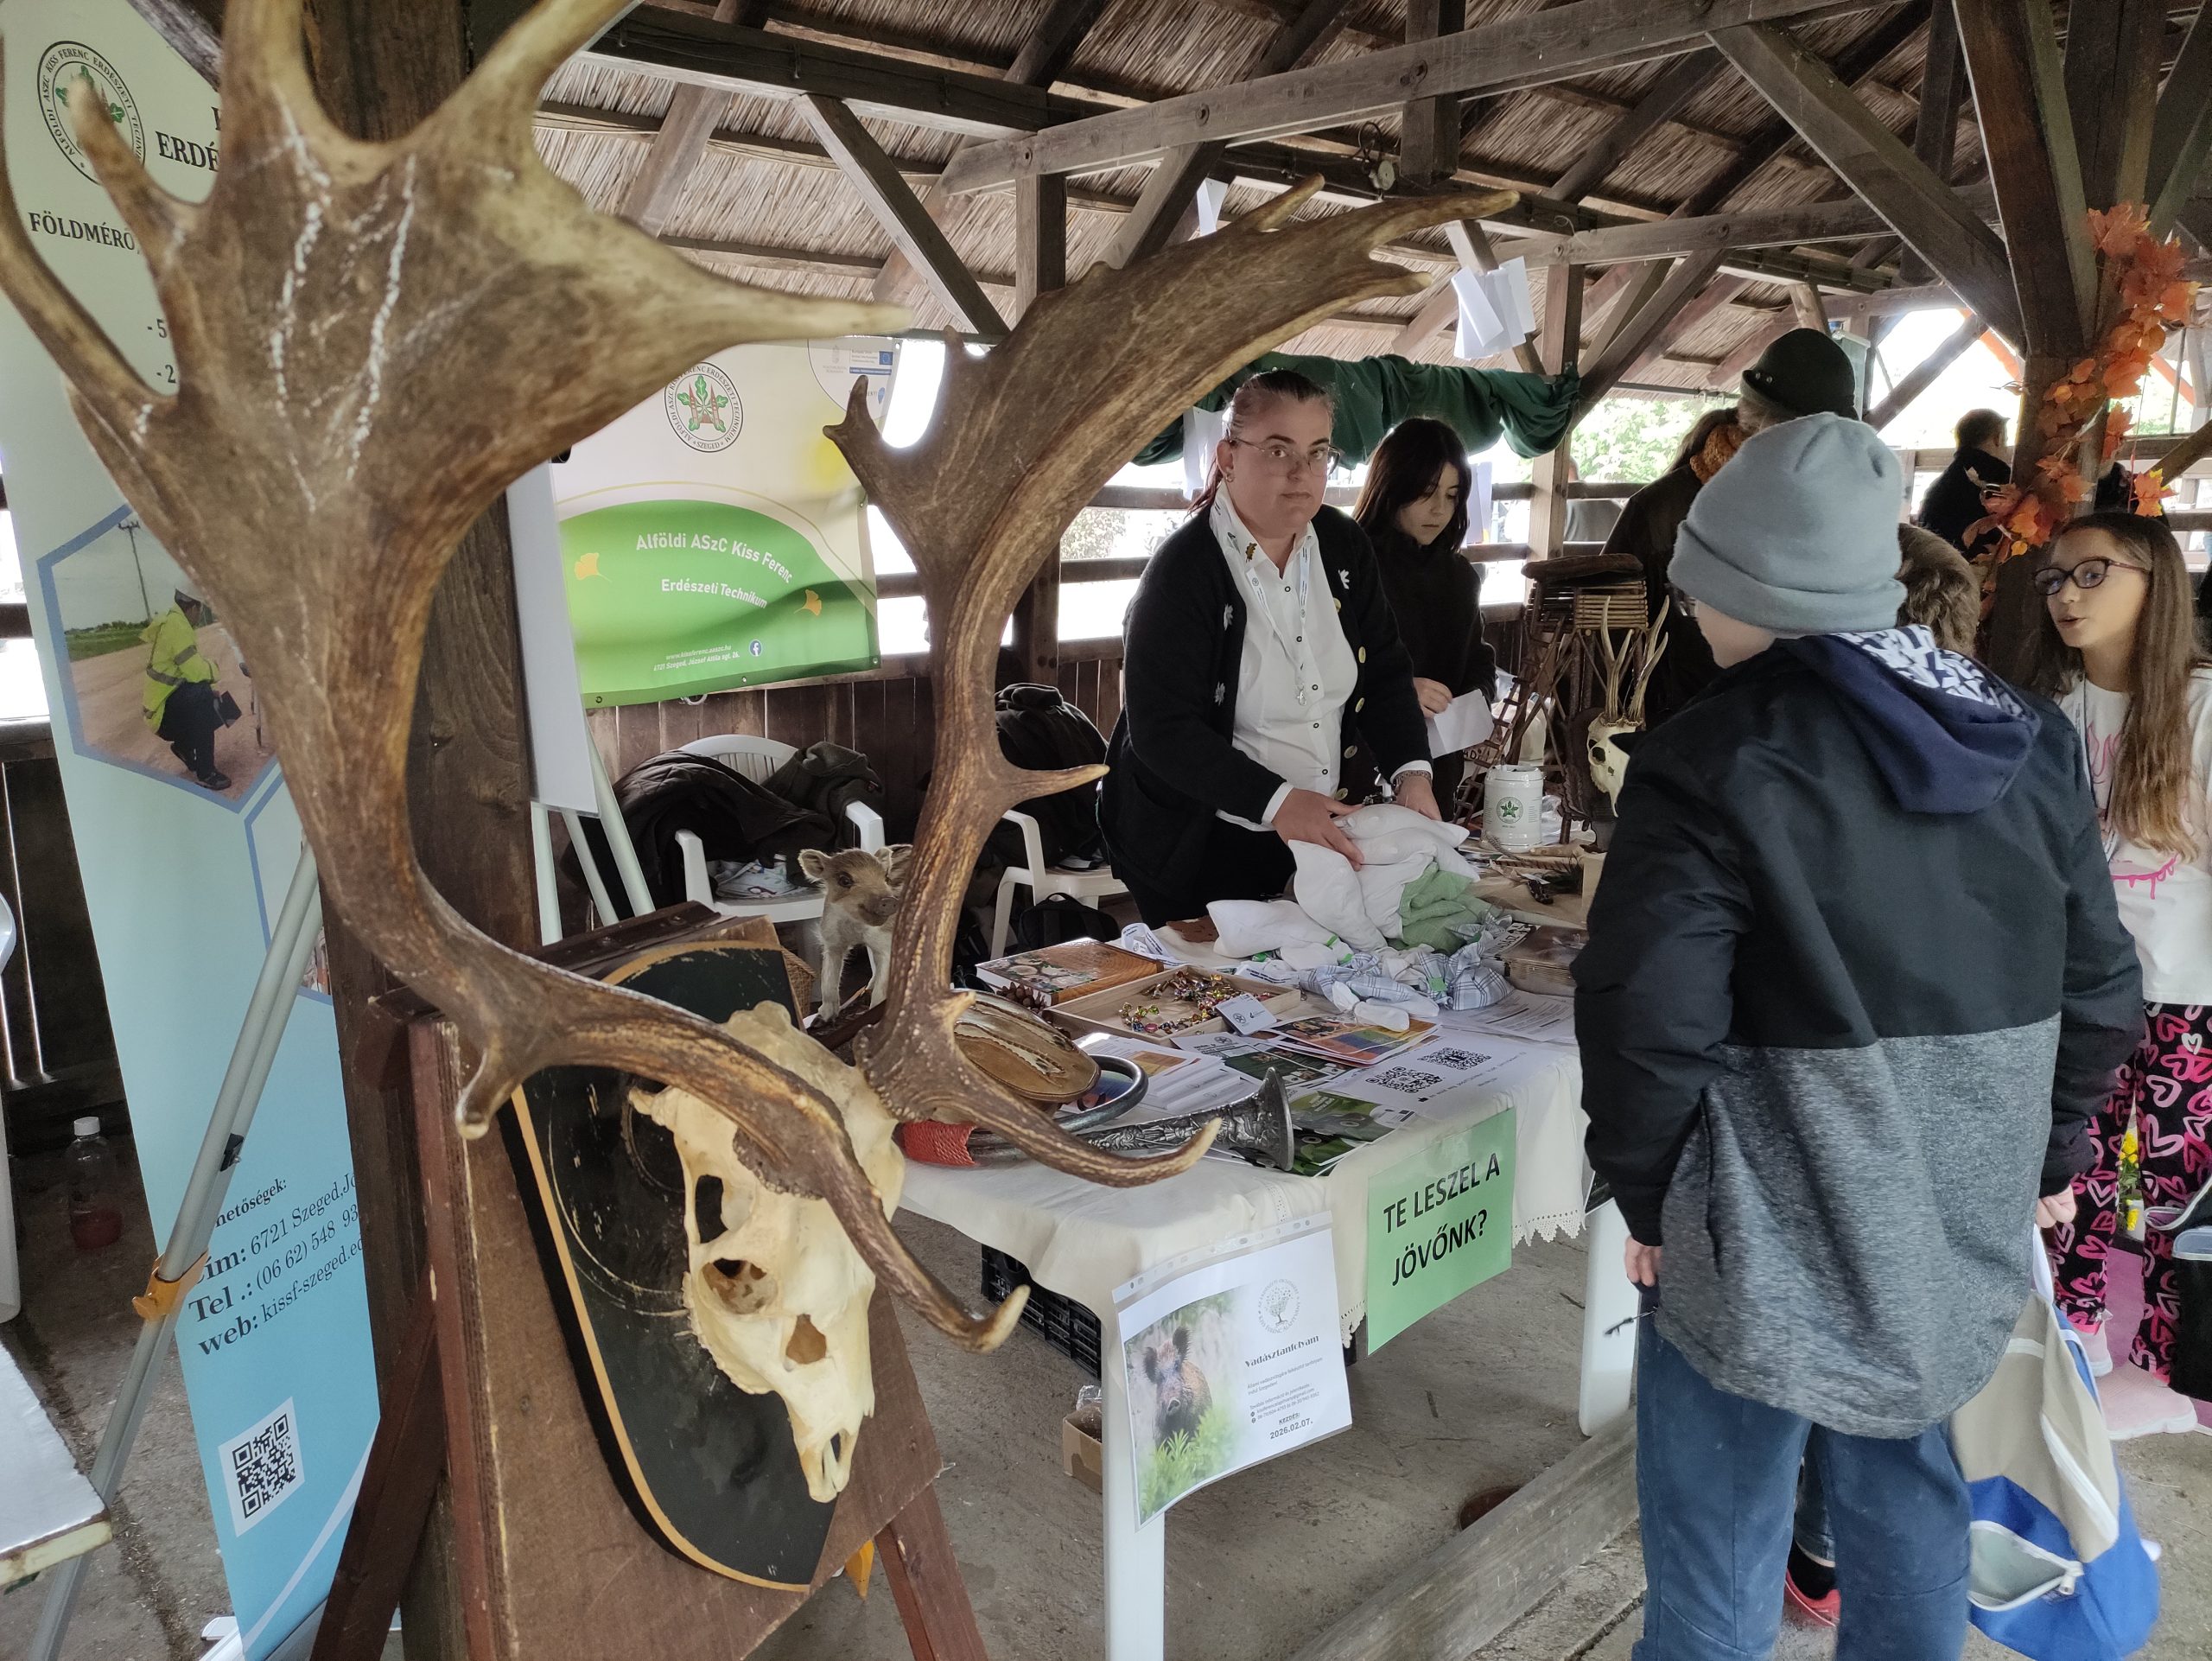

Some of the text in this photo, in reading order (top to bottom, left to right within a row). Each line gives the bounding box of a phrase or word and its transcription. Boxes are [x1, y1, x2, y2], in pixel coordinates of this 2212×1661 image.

[45, 54, 59, 73] KISS
[58, 48, 89, 60] FERENC
[131, 115, 143, 160] TECHNI
[724, 402, 741, 443] TECHNIKUM
[636, 531, 793, 584] Alföldi ASzC Kiss Ferenc
[661, 577, 768, 609] Erdészeti Technikum
[1383, 1152, 1501, 1234] TE LESZEL A
[188, 1285, 234, 1323] Tel
[256, 1258, 282, 1291] (06
[285, 1240, 308, 1270] 62)
[311, 1219, 337, 1251] 548
[197, 1247, 247, 1284] ím:
[251, 1218, 289, 1255] 6721
[1392, 1208, 1488, 1287] JÖVŐNK?
[197, 1314, 258, 1356] web:
[1244, 1335, 1320, 1368] Vadásztanfolyam
[1269, 1417, 1313, 1440] 2026.02.07.
